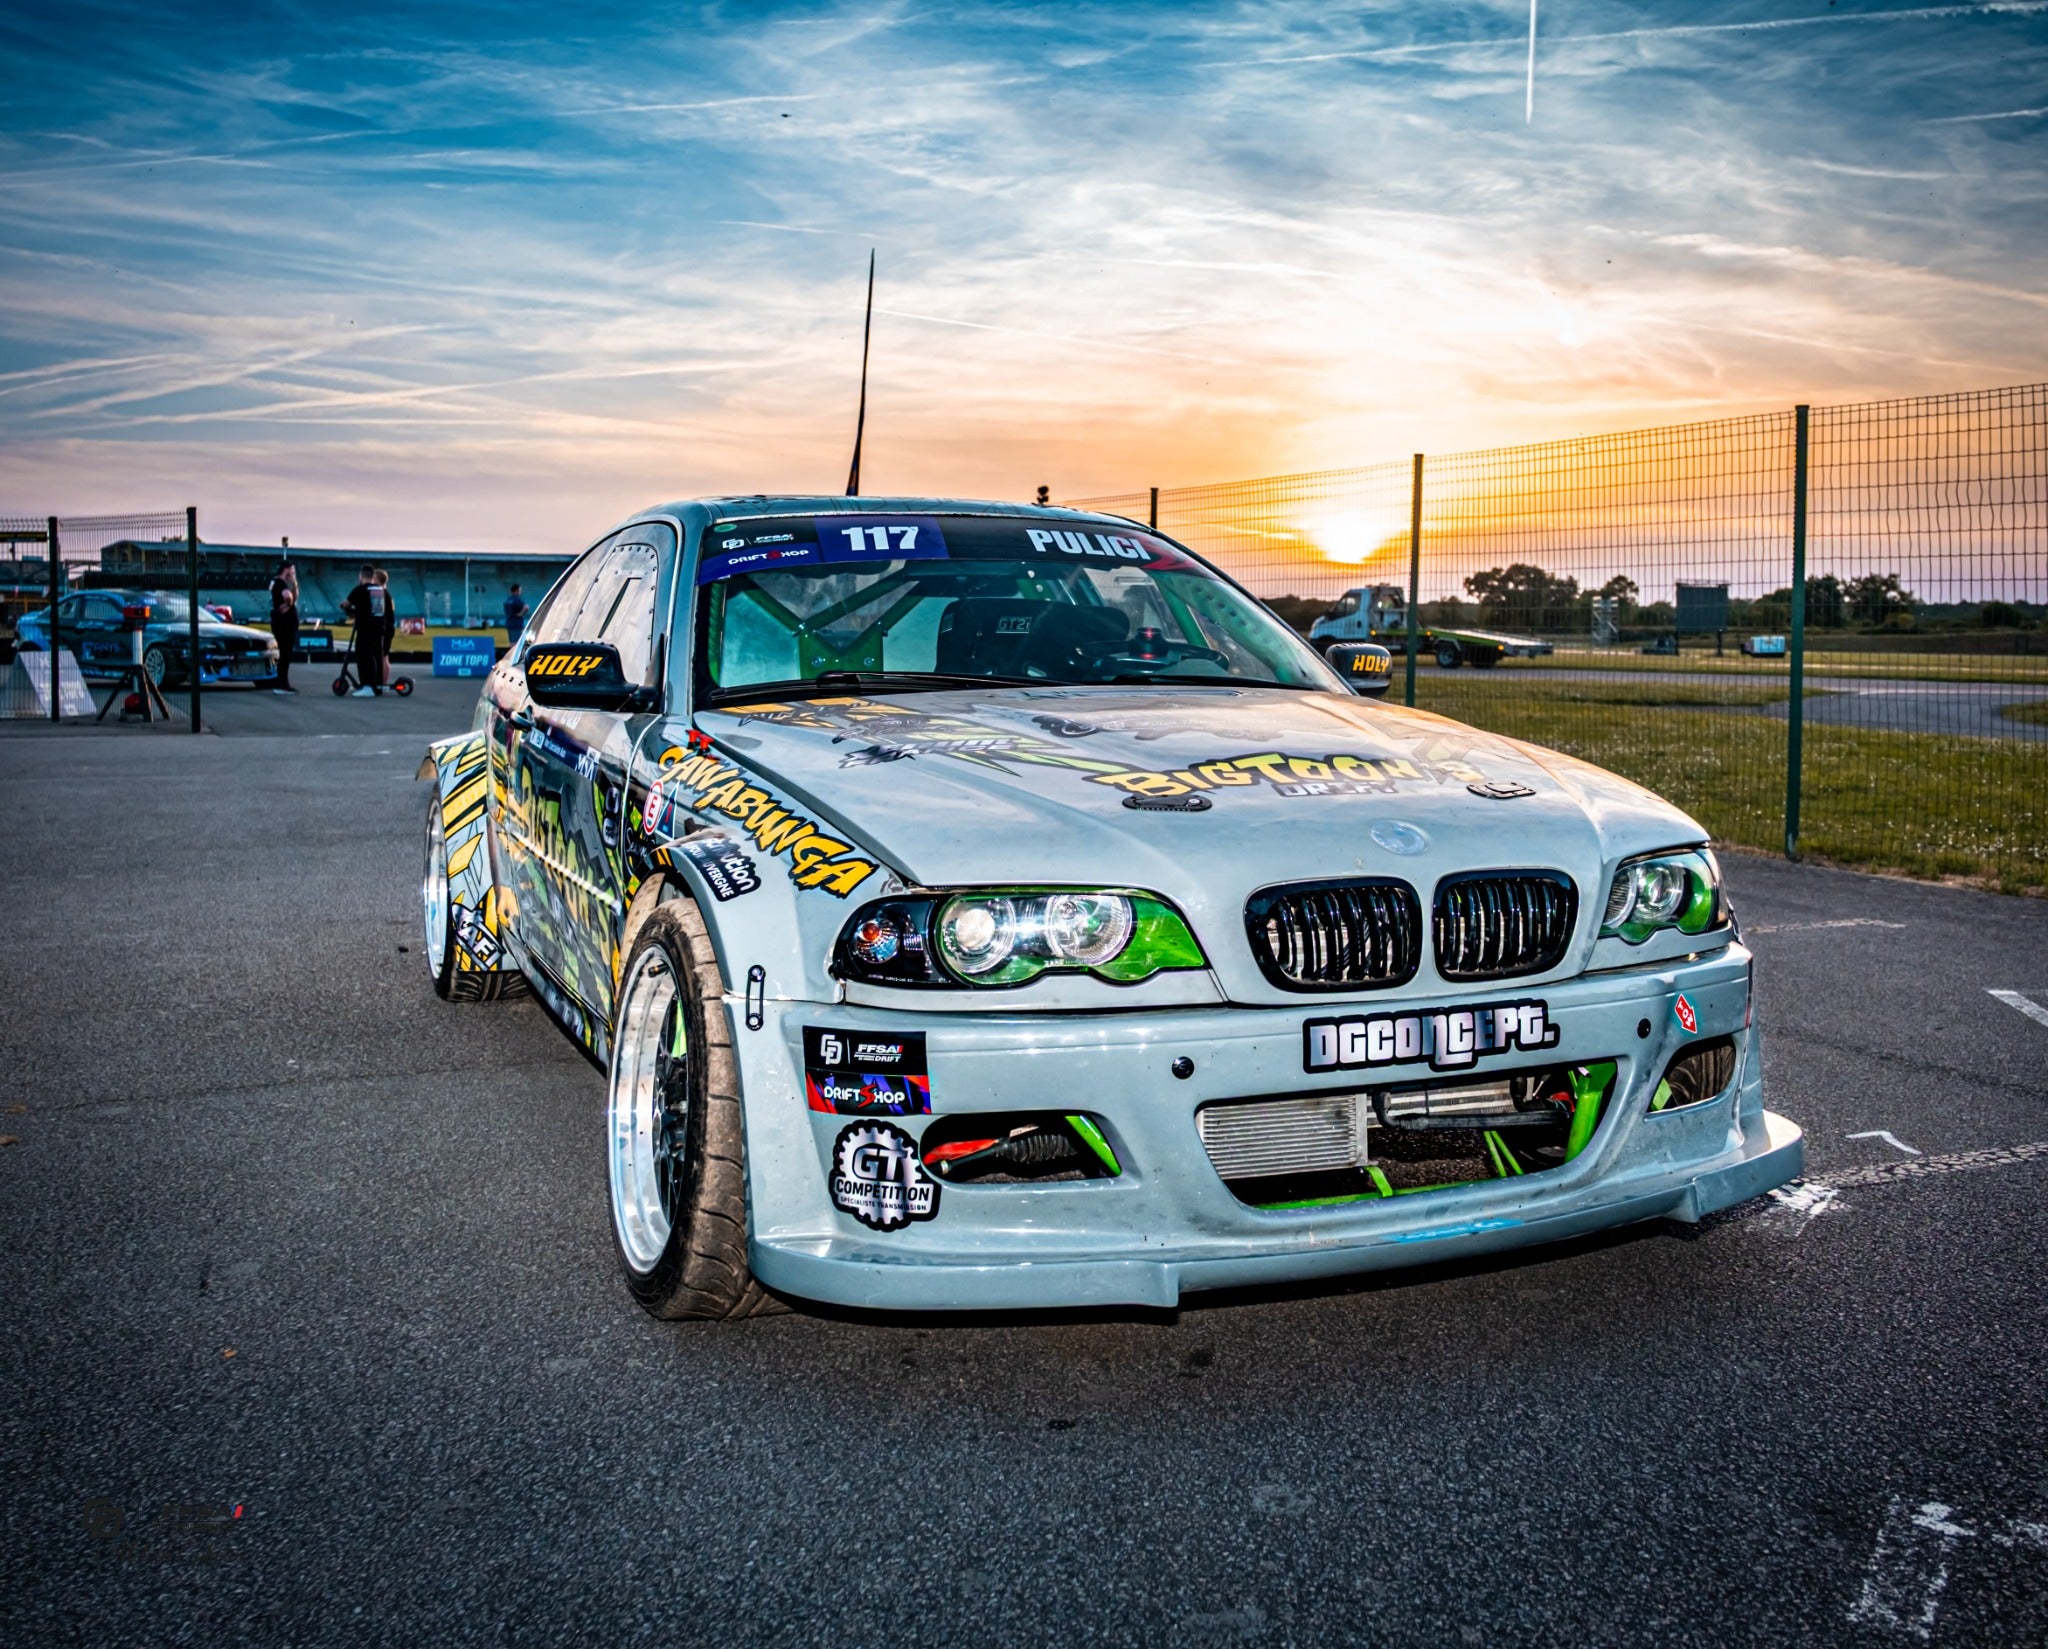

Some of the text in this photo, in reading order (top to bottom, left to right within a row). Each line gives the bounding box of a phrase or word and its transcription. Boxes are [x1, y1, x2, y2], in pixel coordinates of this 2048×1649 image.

[841, 526, 919, 551] 117
[1026, 529, 1151, 560] PULICI
[440, 655, 463, 666] ZONE
[528, 655, 603, 676] HOLY
[1353, 655, 1390, 673] HOLY
[702, 859, 735, 898] UVERGNE
[1677, 1000, 1694, 1027] TOW
[857, 1043, 898, 1054] FFSA
[824, 1084, 905, 1109] DRIFTSHOP
[853, 1147, 908, 1180] GT
[836, 1178, 930, 1202] COMPETITION
